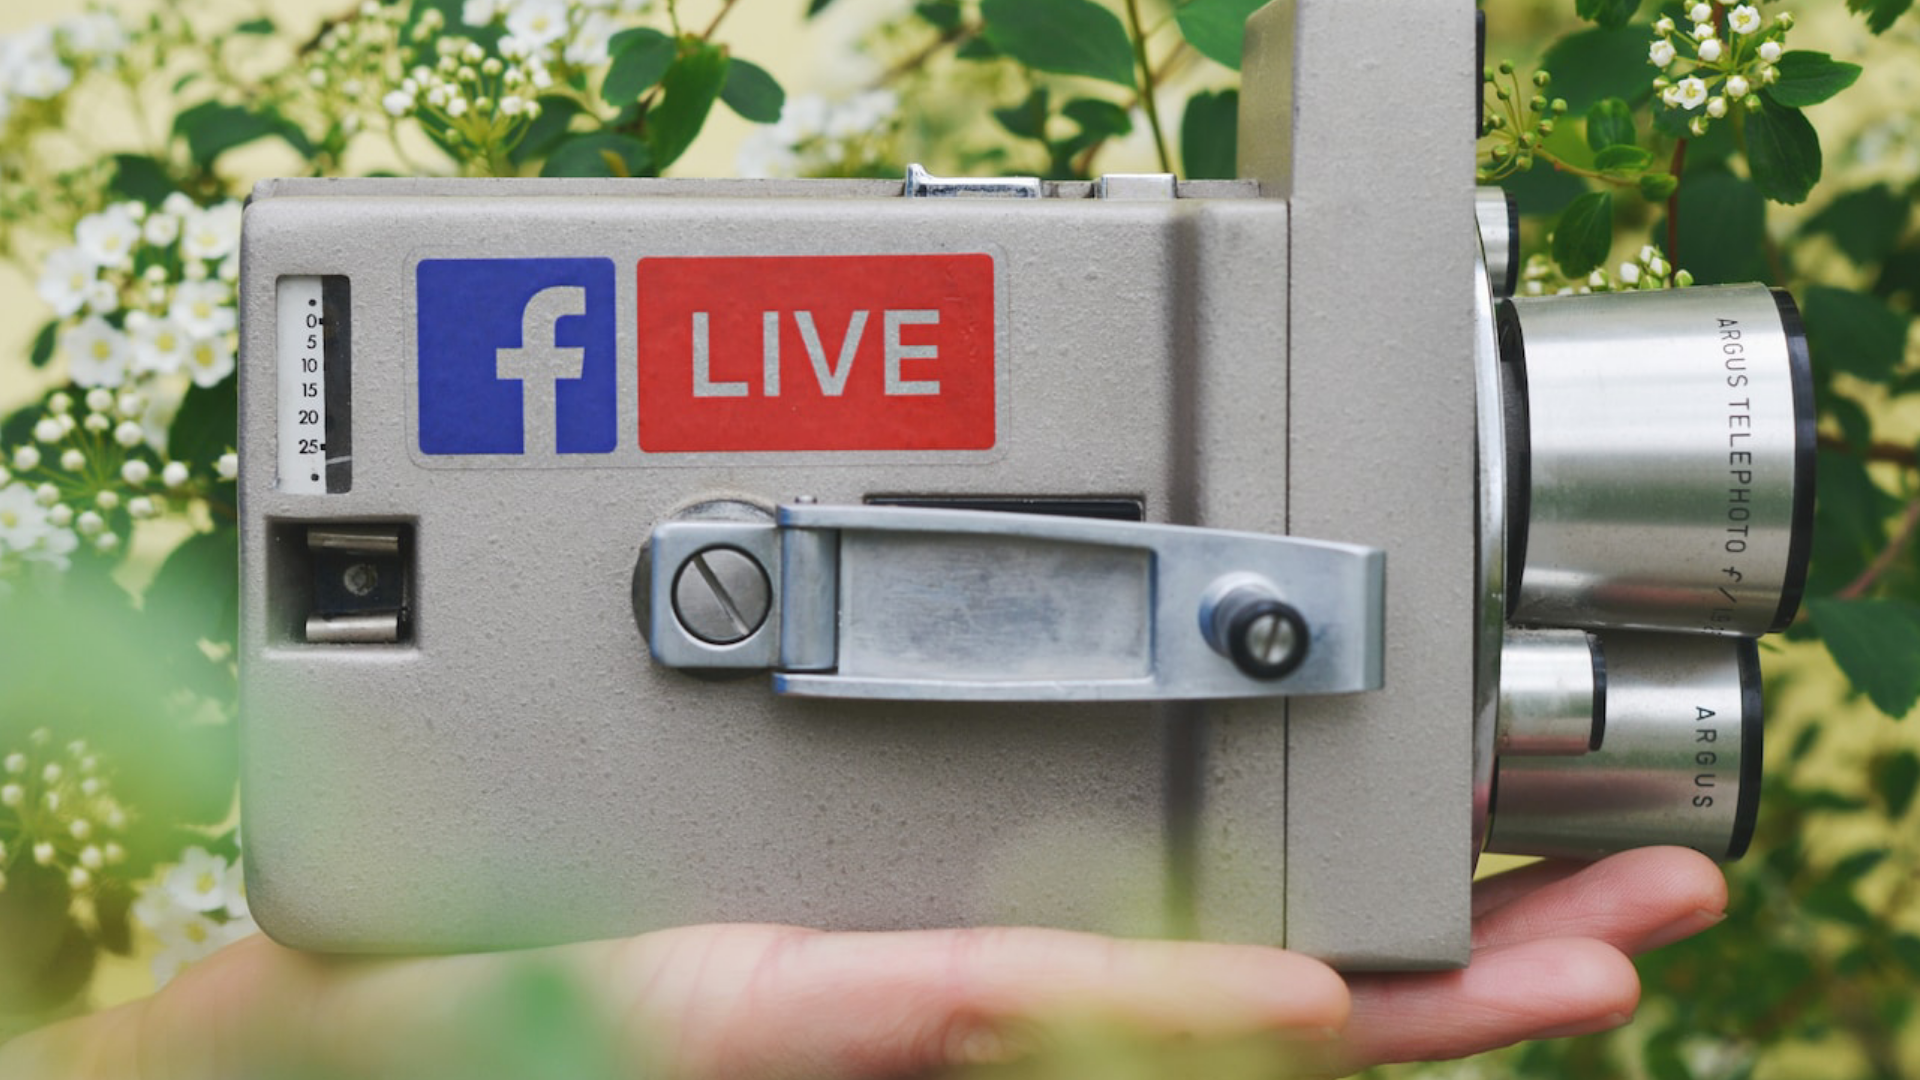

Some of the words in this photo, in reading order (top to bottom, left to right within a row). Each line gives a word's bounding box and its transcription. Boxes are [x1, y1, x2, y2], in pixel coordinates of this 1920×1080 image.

[306, 314, 317, 328] 0
[307, 335, 317, 349] 5
[692, 309, 941, 398] LIVE
[1717, 318, 1749, 387] ARGUS
[301, 358, 318, 373] 10
[302, 383, 318, 397] 15
[299, 410, 319, 424] 20
[299, 439, 319, 454] 25
[1725, 397, 1752, 553] TELEPHOTO
[1692, 706, 1717, 808] ARGUS
